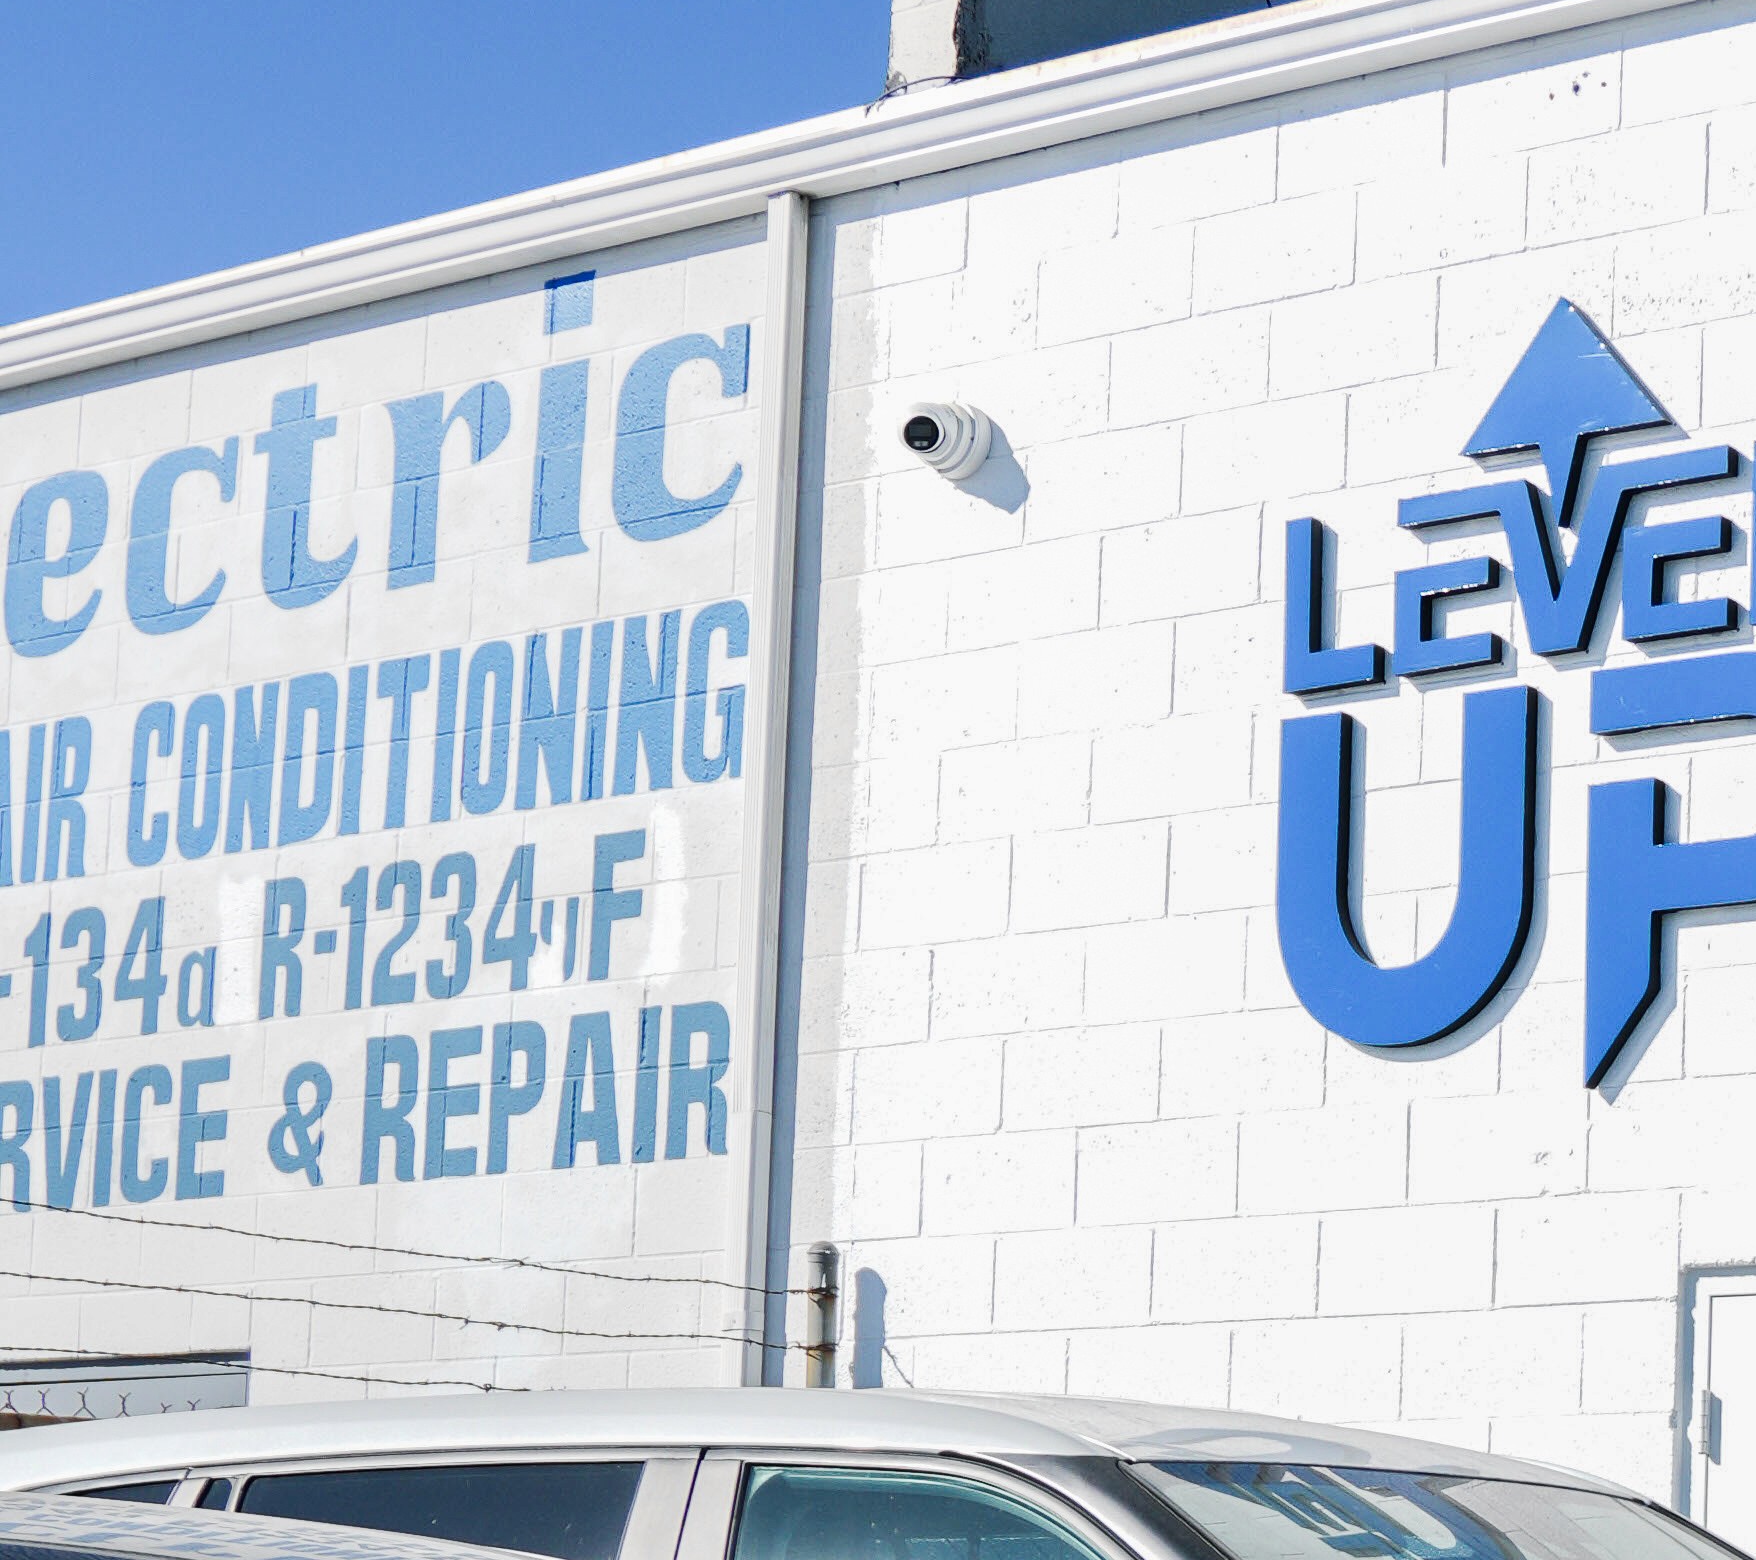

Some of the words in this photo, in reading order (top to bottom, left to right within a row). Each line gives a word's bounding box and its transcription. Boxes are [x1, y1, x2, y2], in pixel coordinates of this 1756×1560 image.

[3, 270, 751, 659] ectric
[0, 715, 92, 888] IR
[126, 599, 750, 868] CONDITIONING
[267, 1060, 332, 1186] &
[360, 1001, 730, 1186] REPAIR
